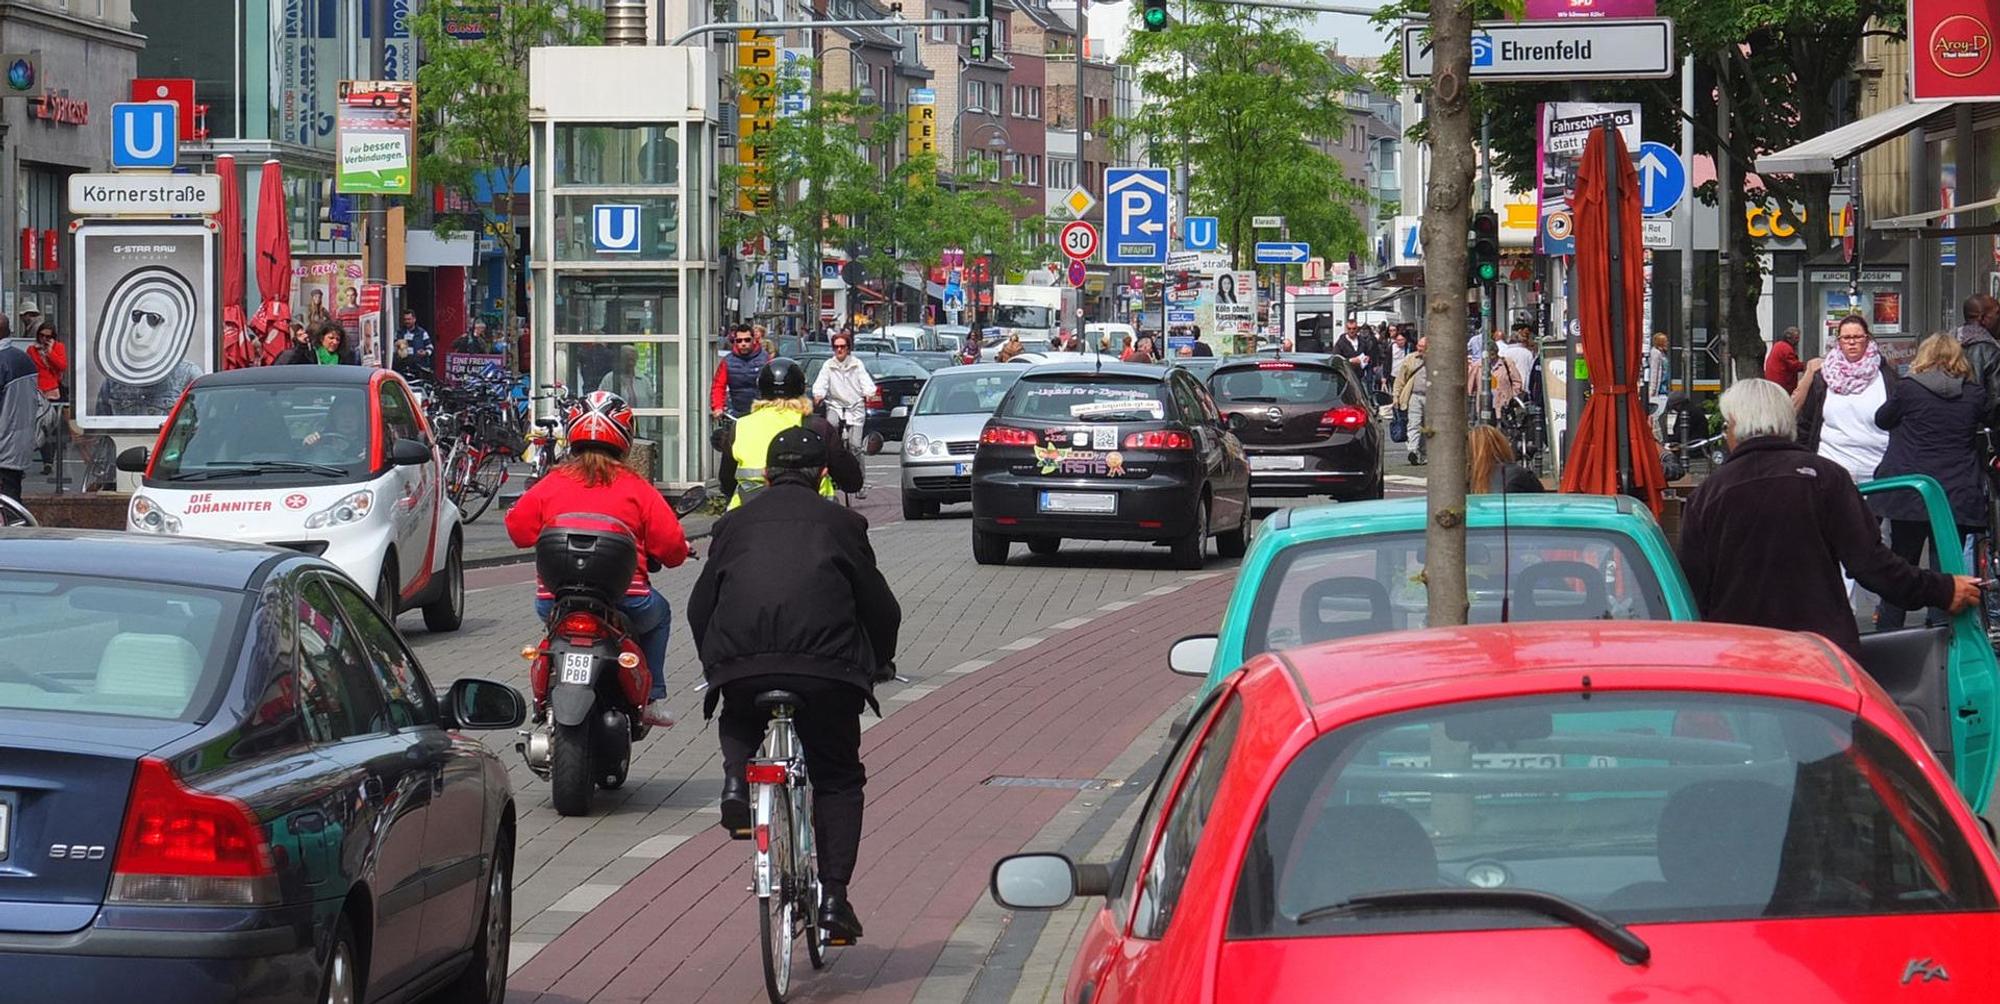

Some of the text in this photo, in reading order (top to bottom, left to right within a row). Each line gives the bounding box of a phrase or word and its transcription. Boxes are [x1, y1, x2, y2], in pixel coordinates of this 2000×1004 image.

[1934, 34, 1988, 52] Aroy-D
[1501, 40, 1592, 61] Ehrenfeld
[124, 112, 163, 159] U
[363, 141, 401, 152] bessere
[1553, 138, 1578, 151] statt
[344, 152, 404, 164] Verbindungen.
[83, 185, 206, 202] Körnerstraße
[1121, 190, 1152, 236] P
[597, 209, 636, 247] U
[1190, 221, 1211, 246] U
[1647, 223, 1661, 233] Rot
[1068, 232, 1090, 249] 30
[113, 245, 177, 253] G-STAR RAW
[1305, 261, 1321, 279] T
[1215, 305, 1250, 313] Köln ohne
[1060, 460, 1107, 474] TASTE
[190, 493, 213, 504] DIE
[183, 501, 272, 515] JOHANNITER
[567, 654, 590, 668] 568
[565, 667, 588, 682] PBB
